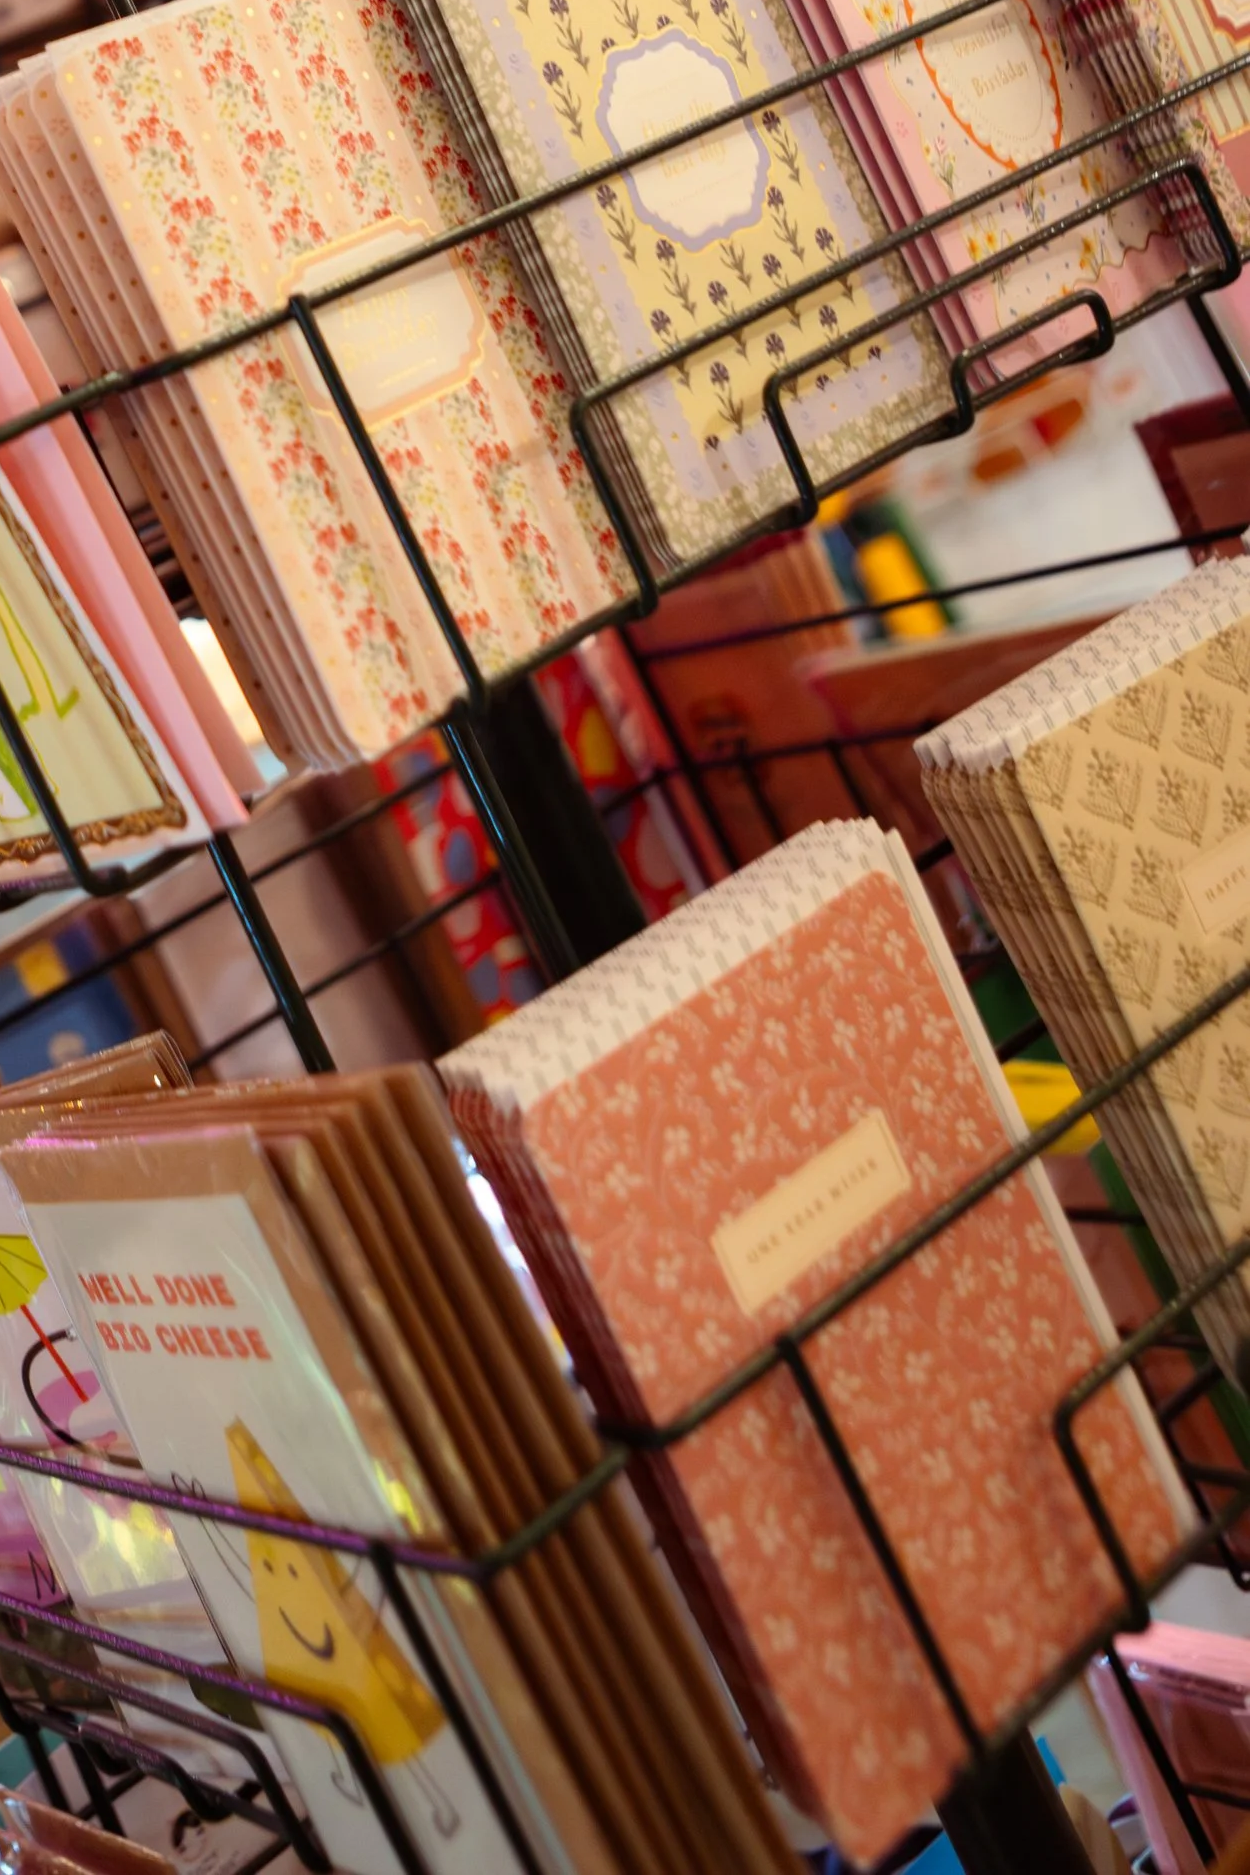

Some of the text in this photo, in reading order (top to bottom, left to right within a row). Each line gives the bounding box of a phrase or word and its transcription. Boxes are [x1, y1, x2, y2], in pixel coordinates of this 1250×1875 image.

[971, 60, 1029, 98] Birthday
[78, 1272, 237, 1309] WELL DONE
[155, 1322, 273, 1362] CHEESE
